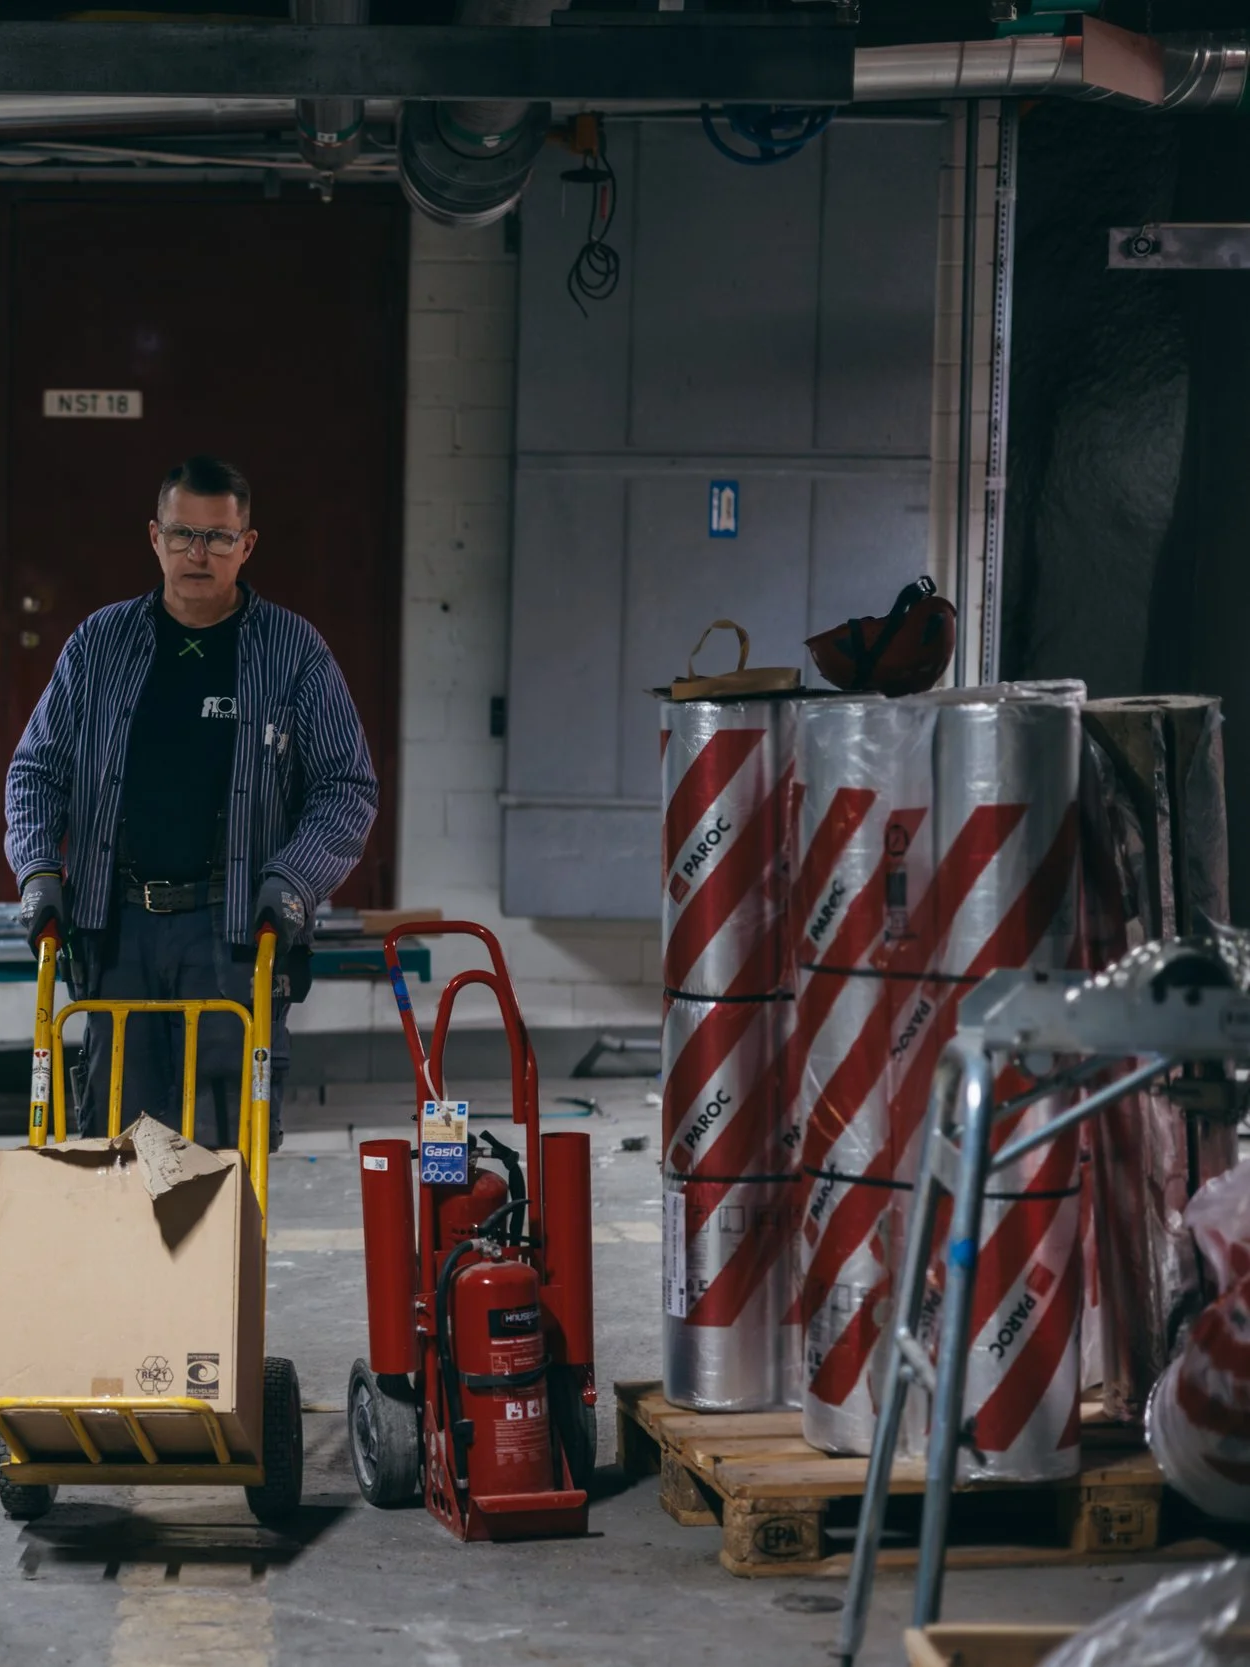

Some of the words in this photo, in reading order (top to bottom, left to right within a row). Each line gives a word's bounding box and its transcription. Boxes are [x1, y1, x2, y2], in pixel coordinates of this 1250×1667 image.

[58, 394, 98, 413] NST
[106, 394, 129, 413] 18
[683, 814, 732, 878] PAROC
[684, 1088, 733, 1150] PAROC
[988, 1293, 1038, 1361] PAROC
[141, 1369, 168, 1381] REZY
